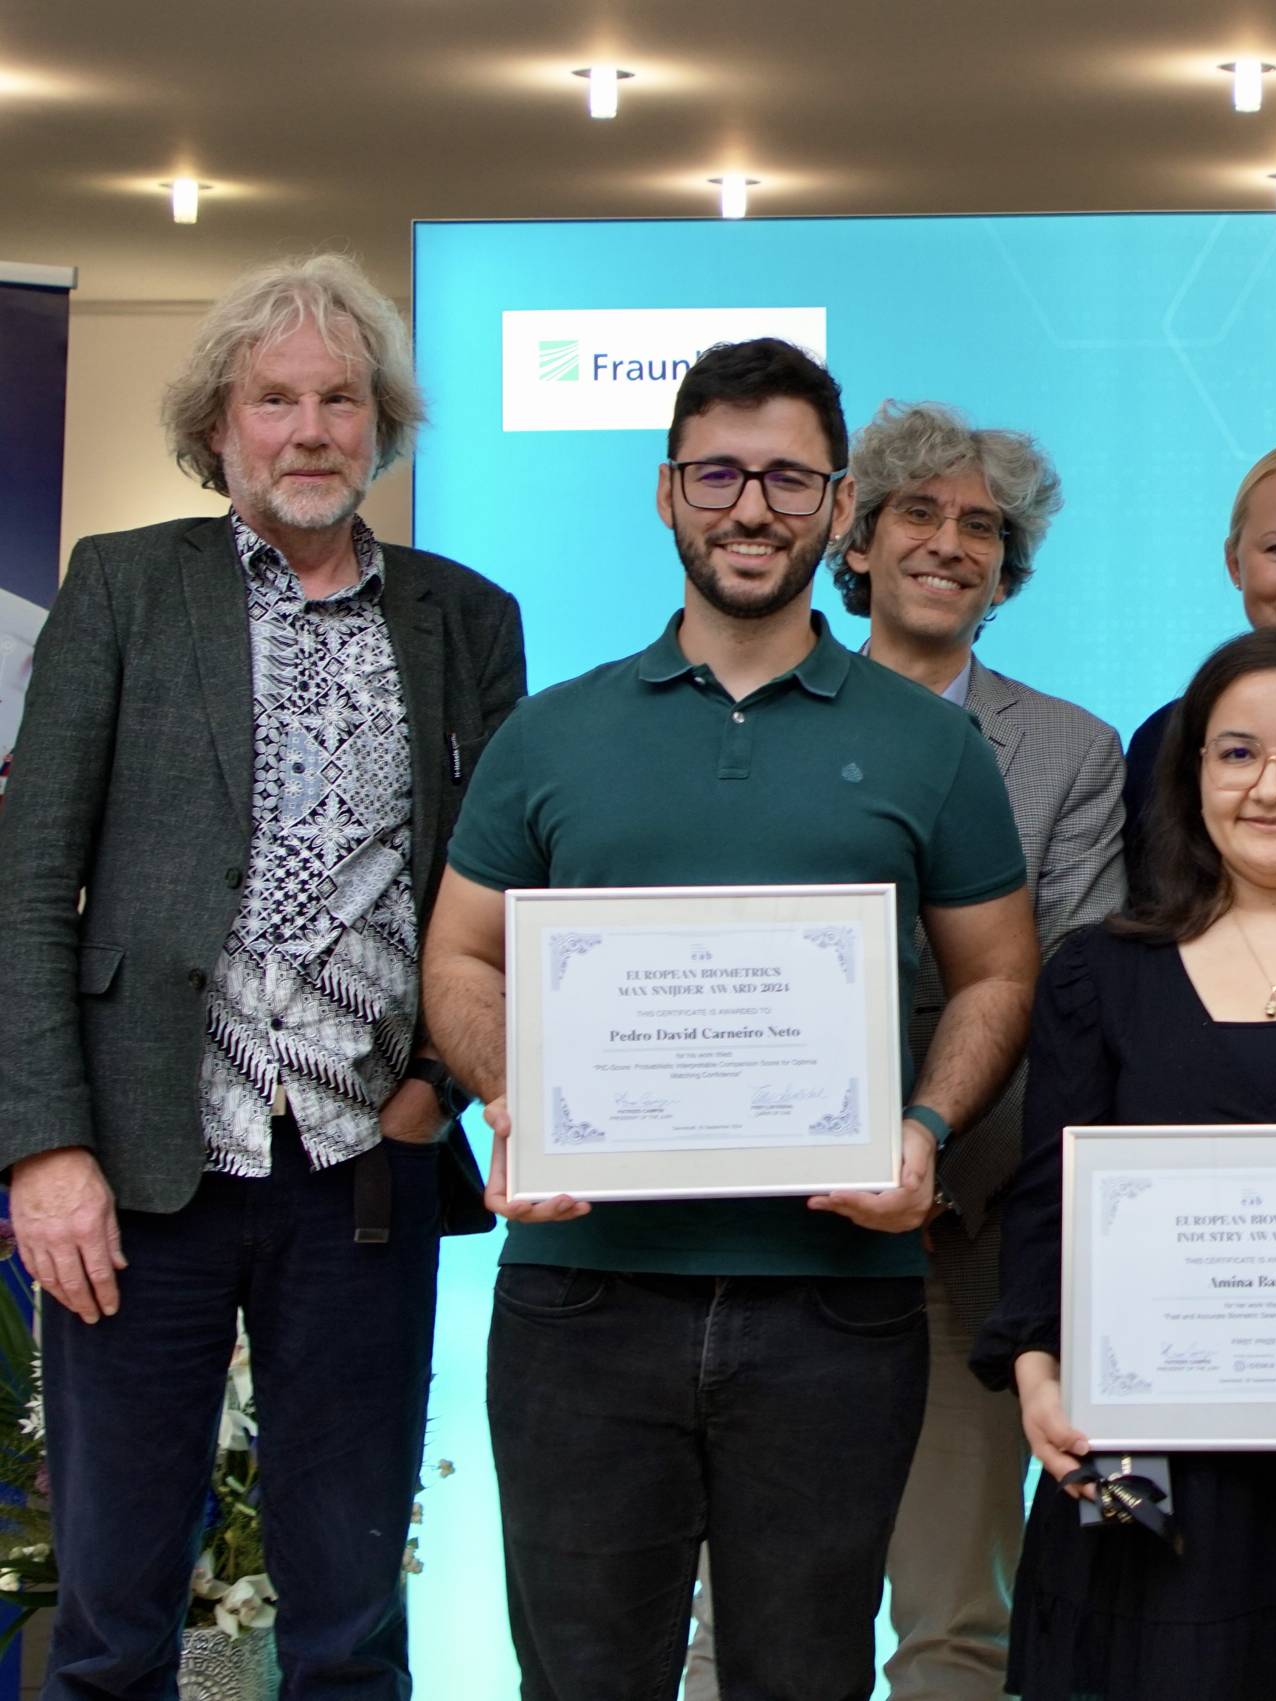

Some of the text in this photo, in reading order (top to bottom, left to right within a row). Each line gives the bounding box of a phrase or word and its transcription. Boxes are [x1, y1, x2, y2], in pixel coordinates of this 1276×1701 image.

[593, 350, 701, 381] Fraun
[626, 967, 782, 981] EUROPEAN BIOMETRICS
[618, 983, 790, 998] MAX SNIJDER AWARD 2024
[656, 1008, 707, 1017] CERTIFICATE
[718, 1007, 758, 1015] AWARDED
[609, 1025, 801, 1042] Pedro David Carneiro Neto
[1175, 1215, 1246, 1226] EUROPEAN
[1177, 1231, 1243, 1243] INDUSTRY
[1210, 1275, 1253, 1288] Amina
